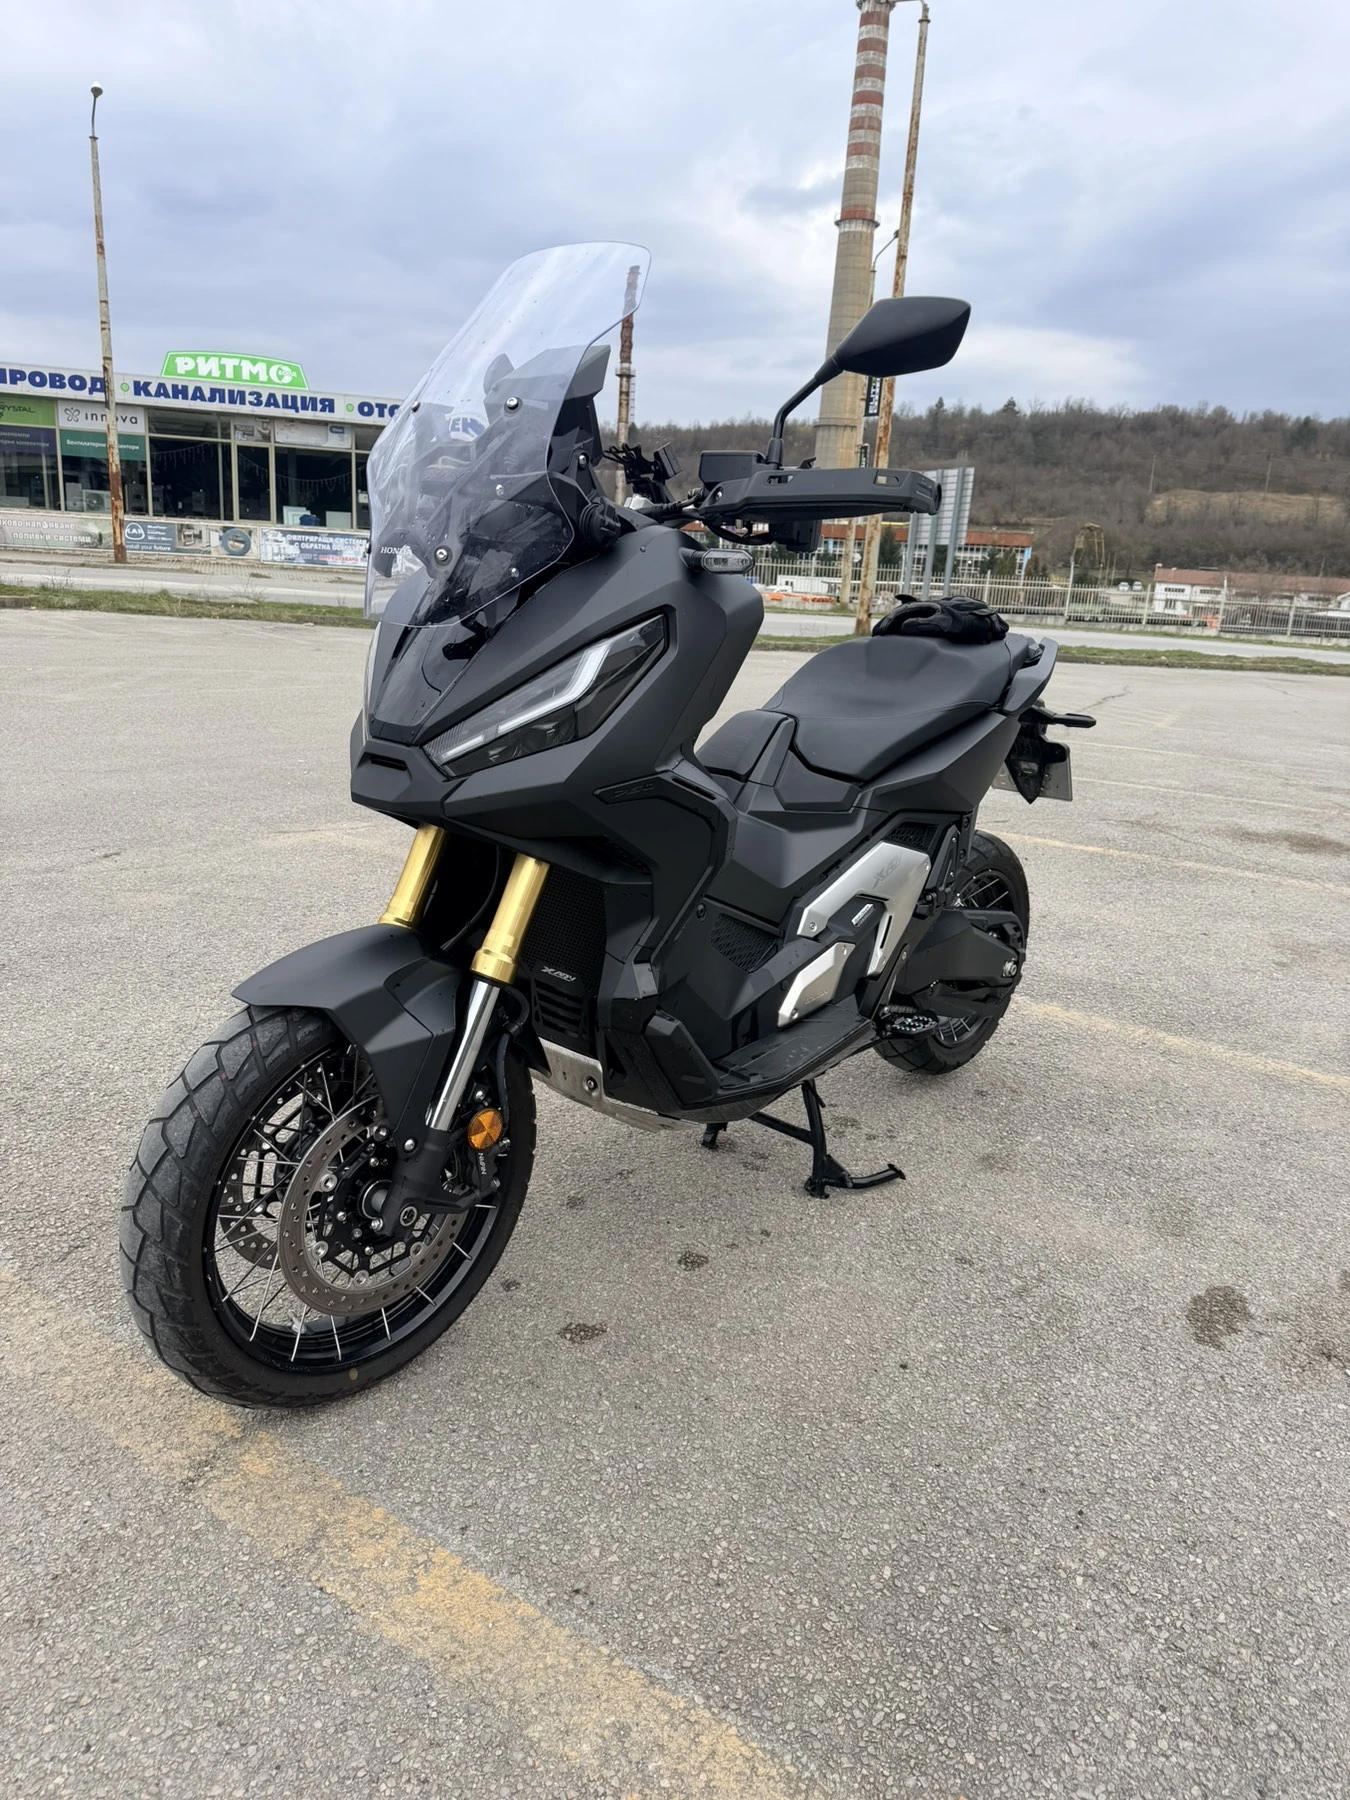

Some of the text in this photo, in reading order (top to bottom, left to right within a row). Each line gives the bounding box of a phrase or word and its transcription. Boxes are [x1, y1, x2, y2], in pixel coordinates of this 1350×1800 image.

[174, 356, 294, 384] РИТМО
[133, 380, 335, 413] КАНАЛИЗАЦИЯ
[85, 413, 138, 425] innva
